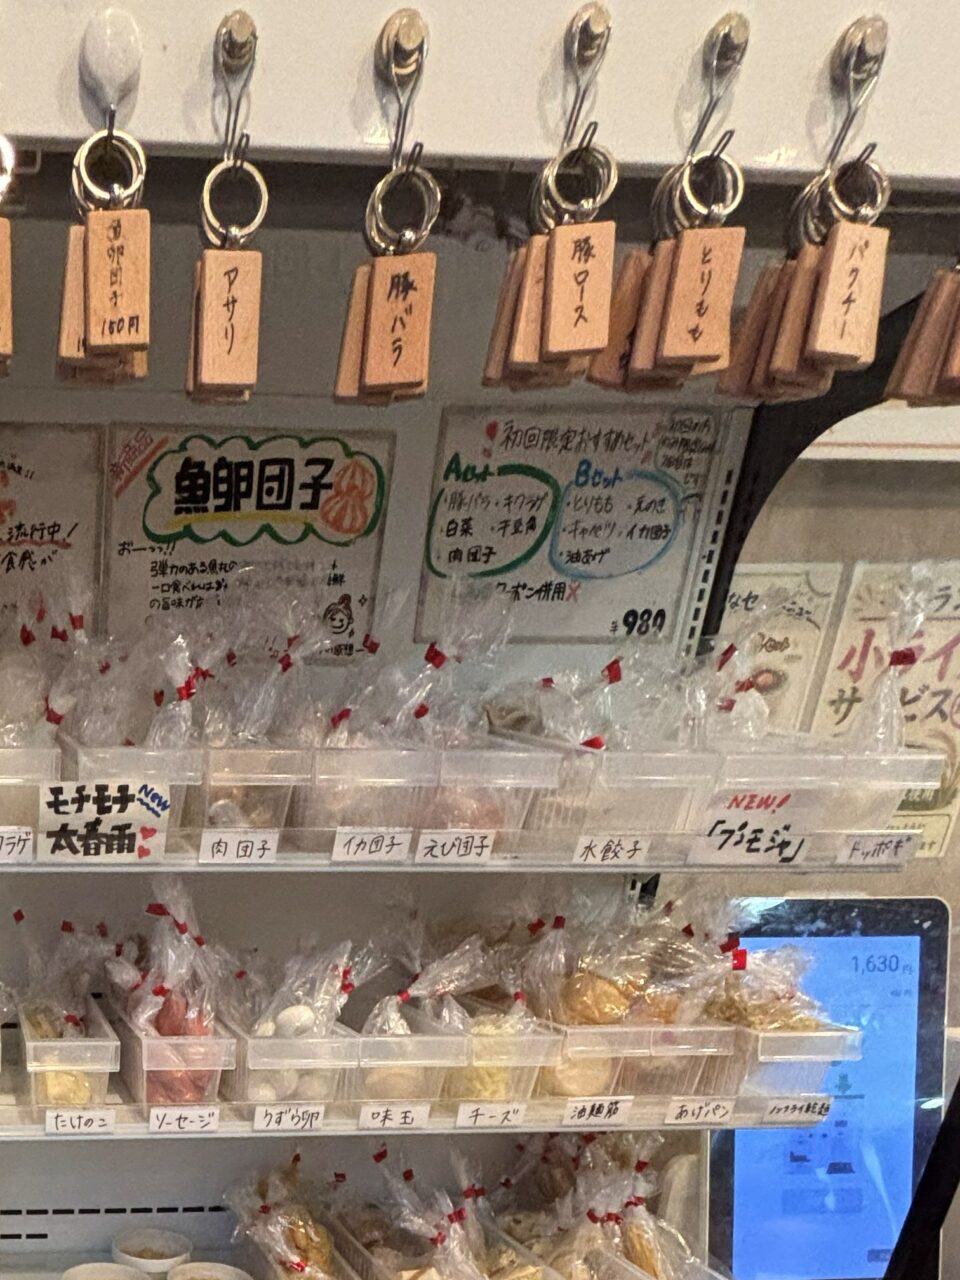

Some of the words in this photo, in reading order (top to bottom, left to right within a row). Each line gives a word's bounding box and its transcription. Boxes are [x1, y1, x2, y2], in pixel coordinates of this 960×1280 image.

[571, 236, 596, 328] 豚ロース
[688, 246, 713, 340] とりもも
[840, 238, 870, 340] パクチー
[223, 266, 239, 354] アサリ
[387, 270, 418, 368] 豚バラ
[173, 457, 335, 515] 魚卵団子
[828, 684, 954, 726] サビス
[46, 784, 136, 815] モチモチ
[727, 792, 792, 815] NEW!
[211, 838, 272, 859] 肉団子
[344, 835, 403, 856] イカ団子
[423, 835, 490, 859] えび団子
[580, 839, 642, 862] 水餃子
[54, 1113, 108, 1131] たけのこ
[154, 1108, 216, 1131] ソーセージ
[263, 1107, 321, 1130] うずら卵
[371, 1109, 415, 1126] 味玉
[469, 1107, 520, 1126] チーズ
[674, 1101, 729, 1120] あげパン
